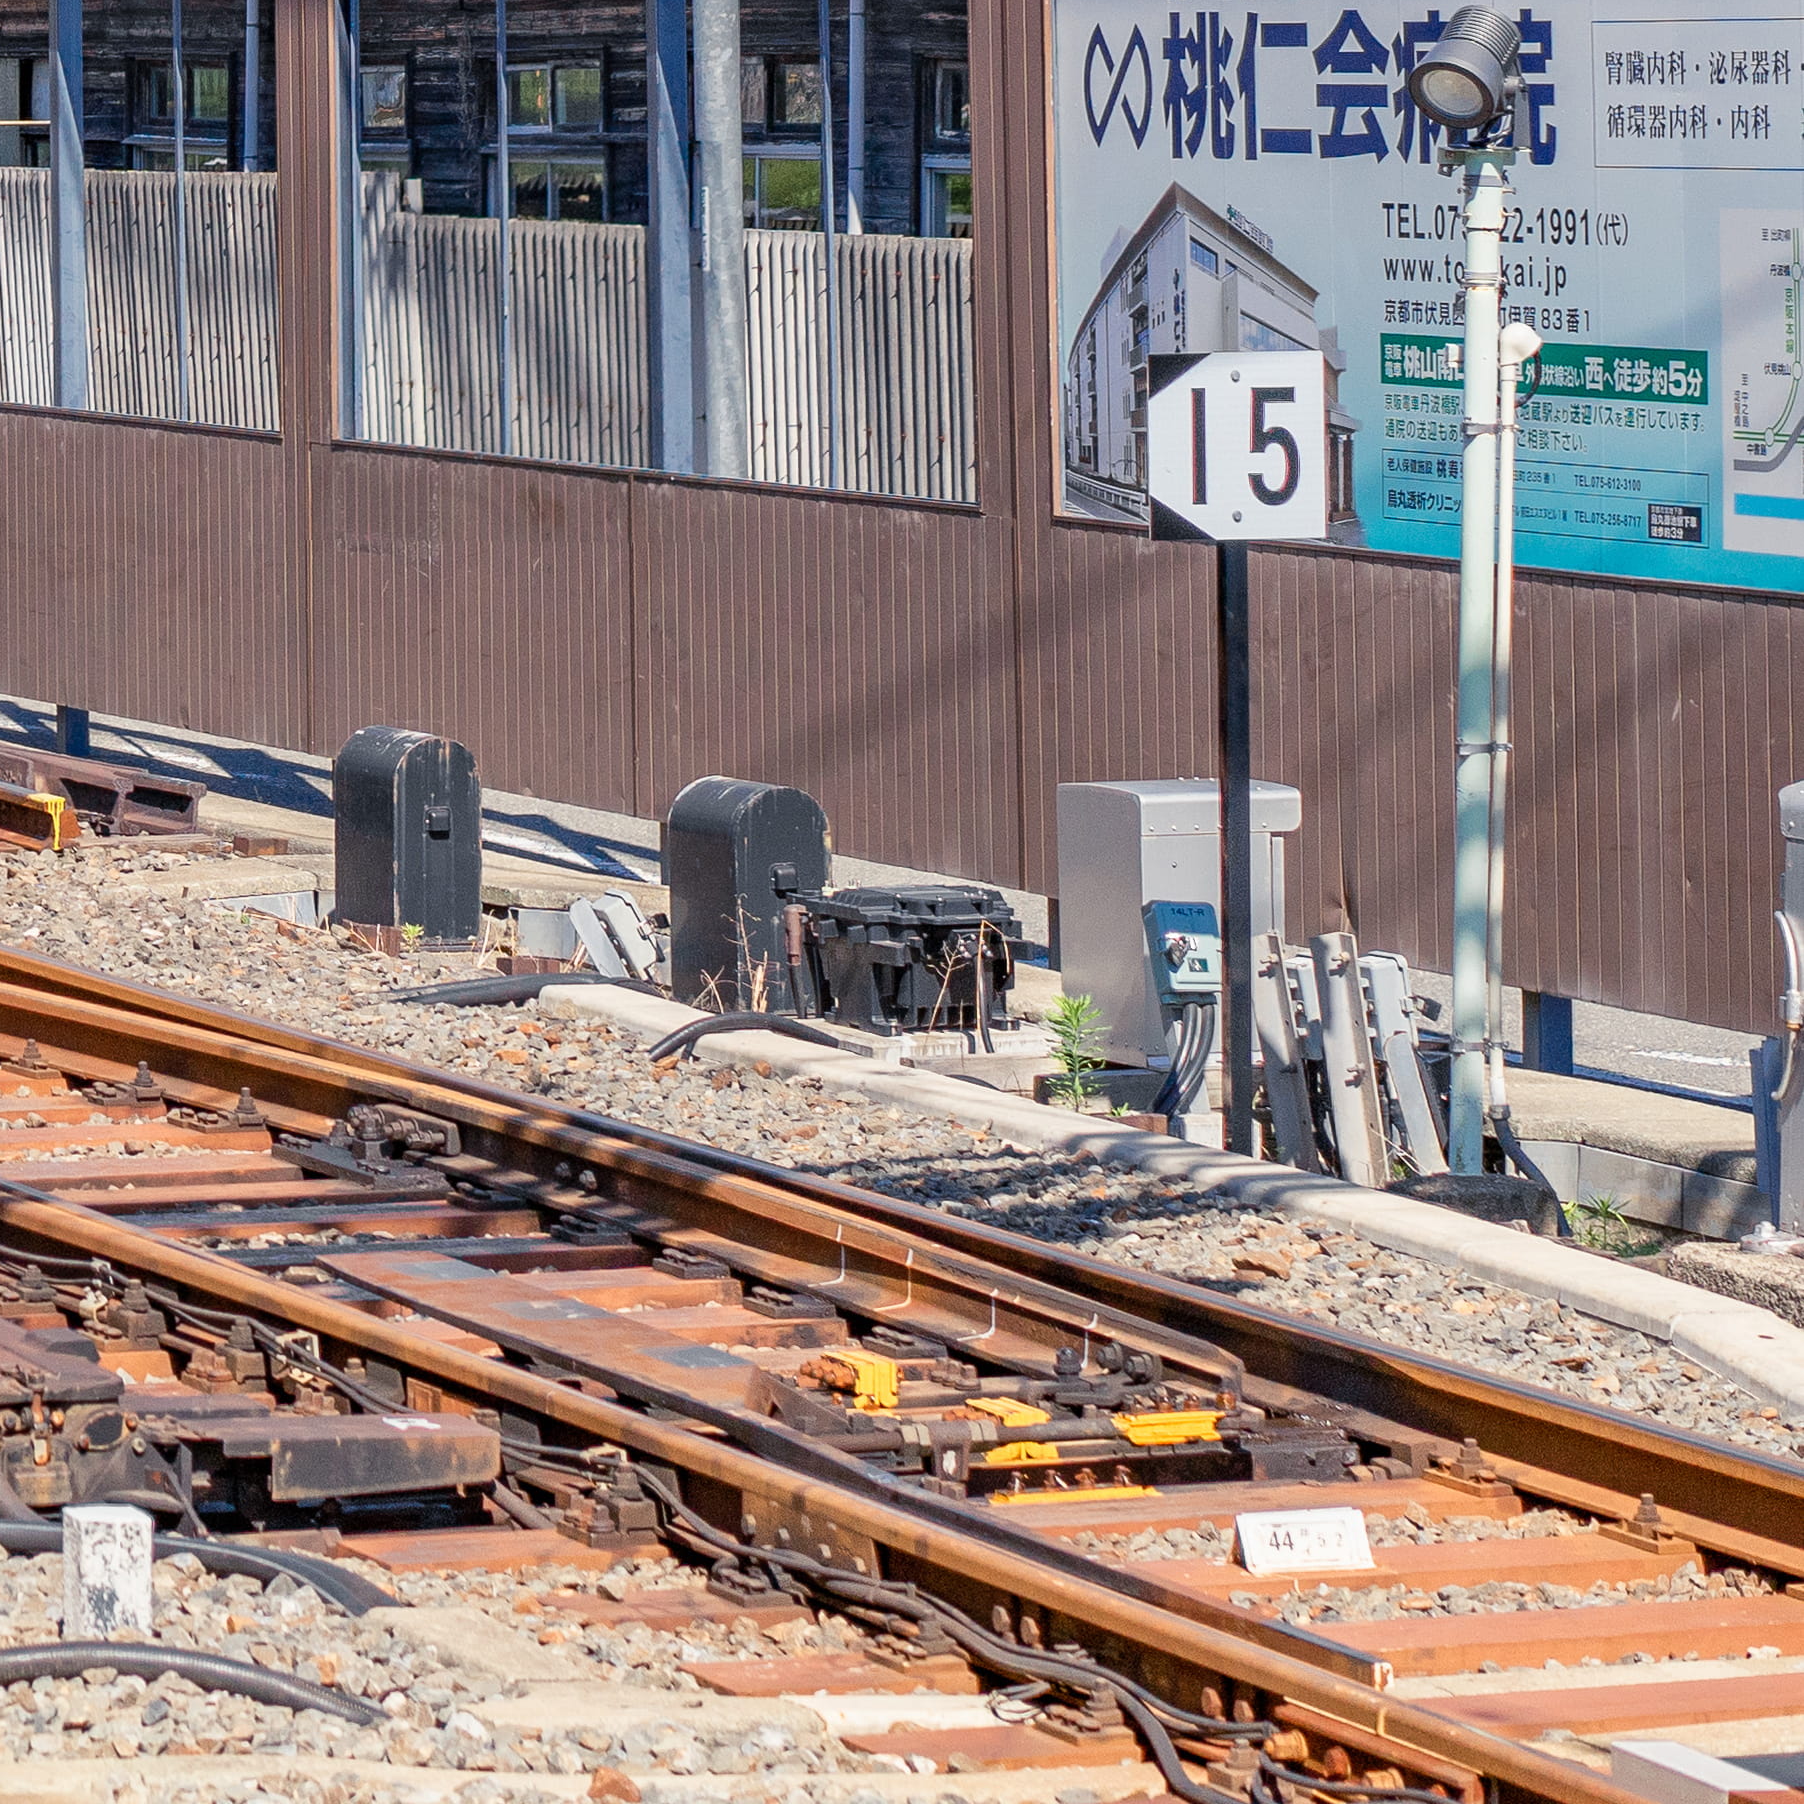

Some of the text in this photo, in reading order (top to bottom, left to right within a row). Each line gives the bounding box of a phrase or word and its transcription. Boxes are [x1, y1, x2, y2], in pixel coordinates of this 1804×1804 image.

[1607, 104, 1771, 140] 循環器内科・内科
[1190, 386, 1301, 507] 15
[1436, 458, 1464, 480] 桃寿
[1171, 907, 1205, 916] 14LT-R
